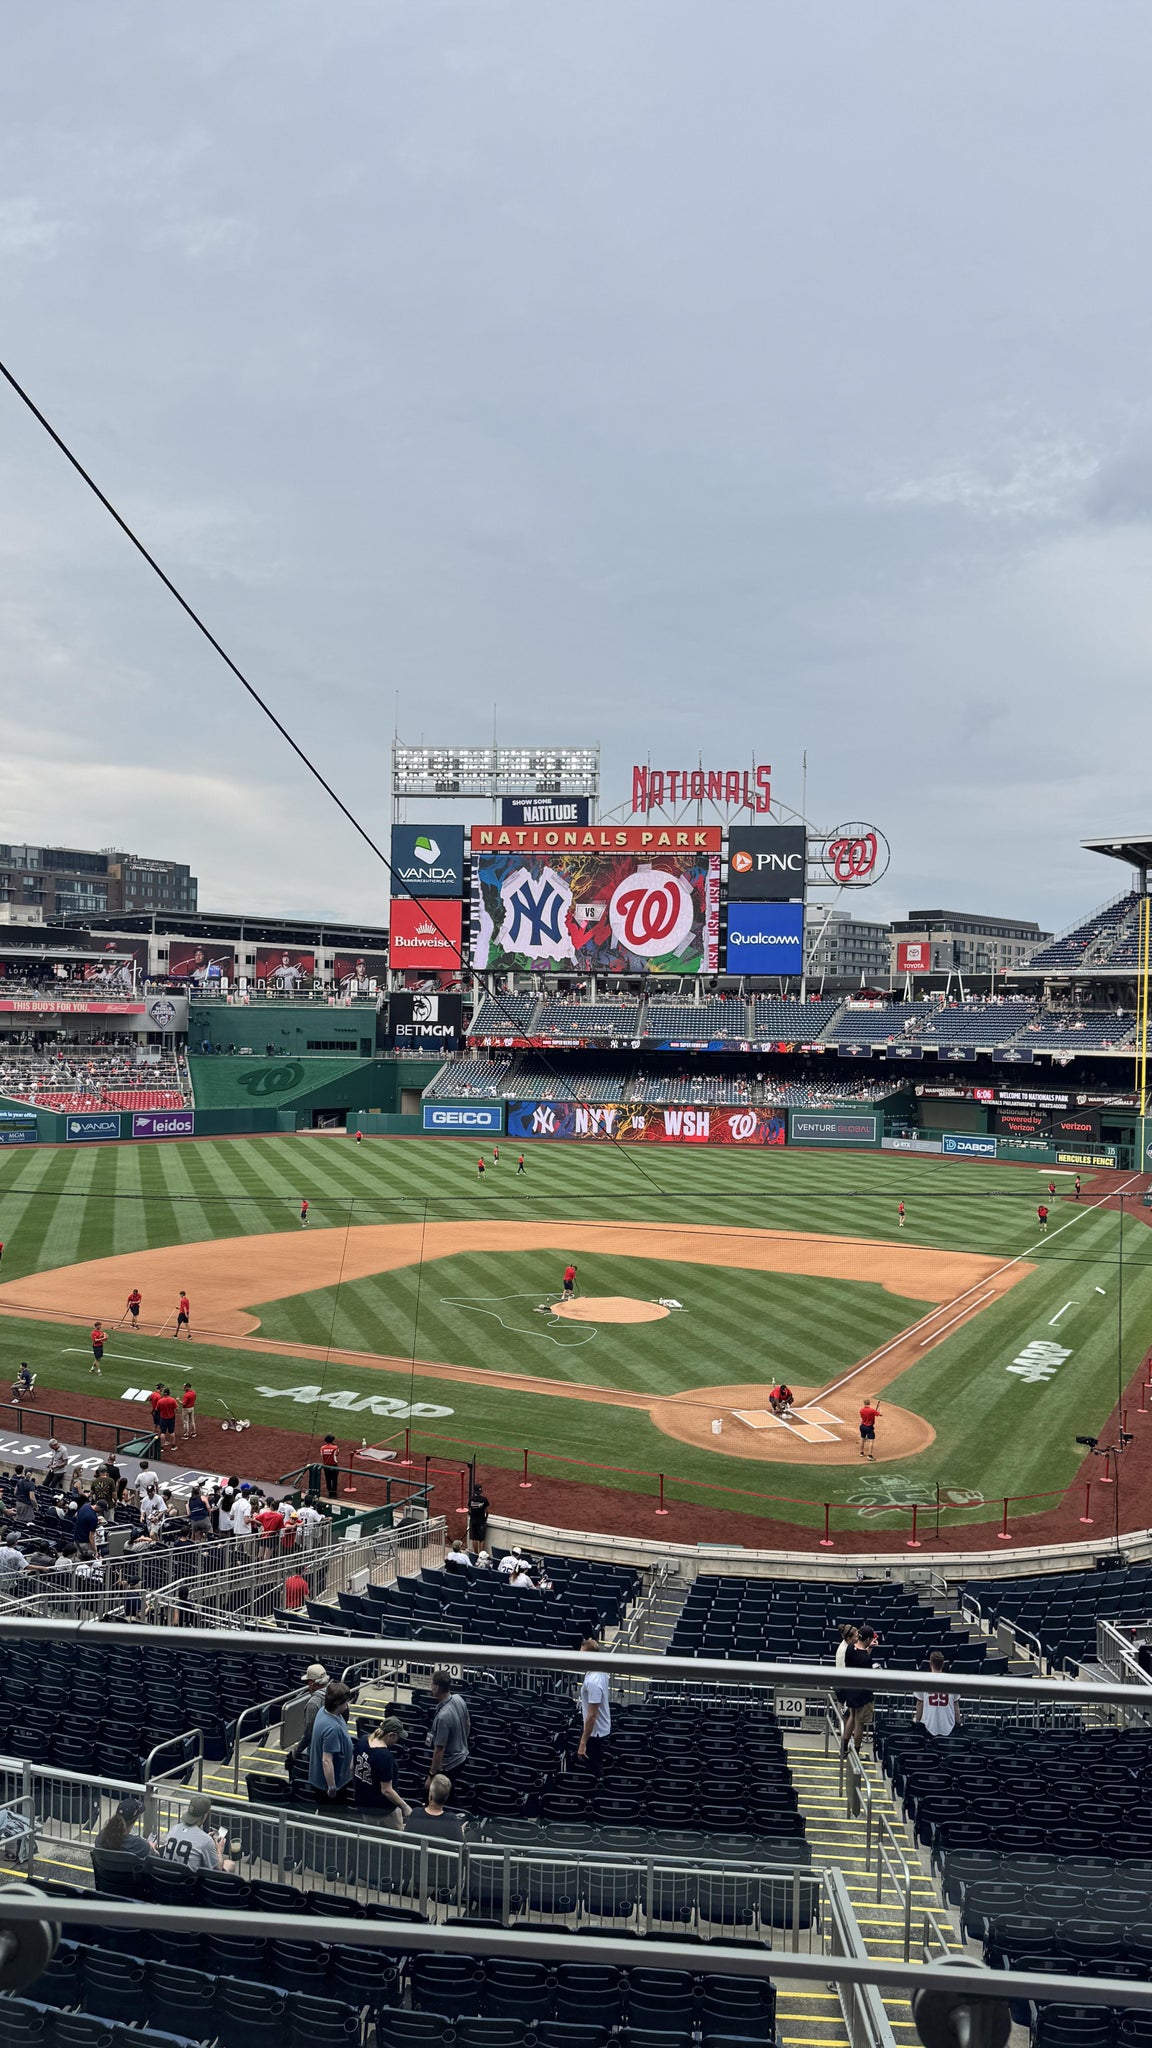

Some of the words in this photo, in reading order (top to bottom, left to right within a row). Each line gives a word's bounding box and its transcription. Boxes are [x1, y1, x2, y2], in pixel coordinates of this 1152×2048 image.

[632, 766, 771, 813] NATIONALS
[523, 804, 578, 822] NATITUDE
[480, 831, 627, 846] NATIONALS
[641, 831, 708, 846] PARK
[756, 854, 802, 871] PNC
[398, 868, 457, 879] VANDA
[585, 907, 595, 918] VS
[394, 935, 457, 948] Budweiser
[730, 932, 800, 946] Qualcomm
[13, 1001, 31, 1010] THIS
[56, 1002, 71, 1011] FOR
[396, 1024, 454, 1037] BETMGM
[976, 1089, 992, 1099] 6:06
[999, 1091, 1020, 1100] WELCOME
[1021, 1092, 1028, 1100] TO
[1028, 1093, 1055, 1101] NATIONALS
[1055, 1094, 1069, 1103] PARK
[432, 1111, 492, 1125] GEICO
[997, 1108, 1029, 1116] Nationals
[1030, 1108, 1048, 1117] Park
[81, 1122, 117, 1131] VANDA
[153, 1119, 191, 1132] leidos
[575, 1108, 615, 1135] NYY
[664, 1111, 710, 1137] WSH
[1001, 1116, 1033, 1124] powered
[1033, 1116, 1042, 1125] by
[1061, 1122, 1092, 1132] verizon
[797, 1124, 836, 1132] VENTURE
[837, 1125, 870, 1133] GLOBAL
[1008, 1123, 1035, 1132] Verizon
[1058, 1153, 1091, 1165] HERCULES
[1092, 1157, 1114, 1166] FENCE
[1005, 1340, 1073, 1383] AARP
[253, 1385, 455, 1419] AARP
[778, 1700, 803, 1712] 120
